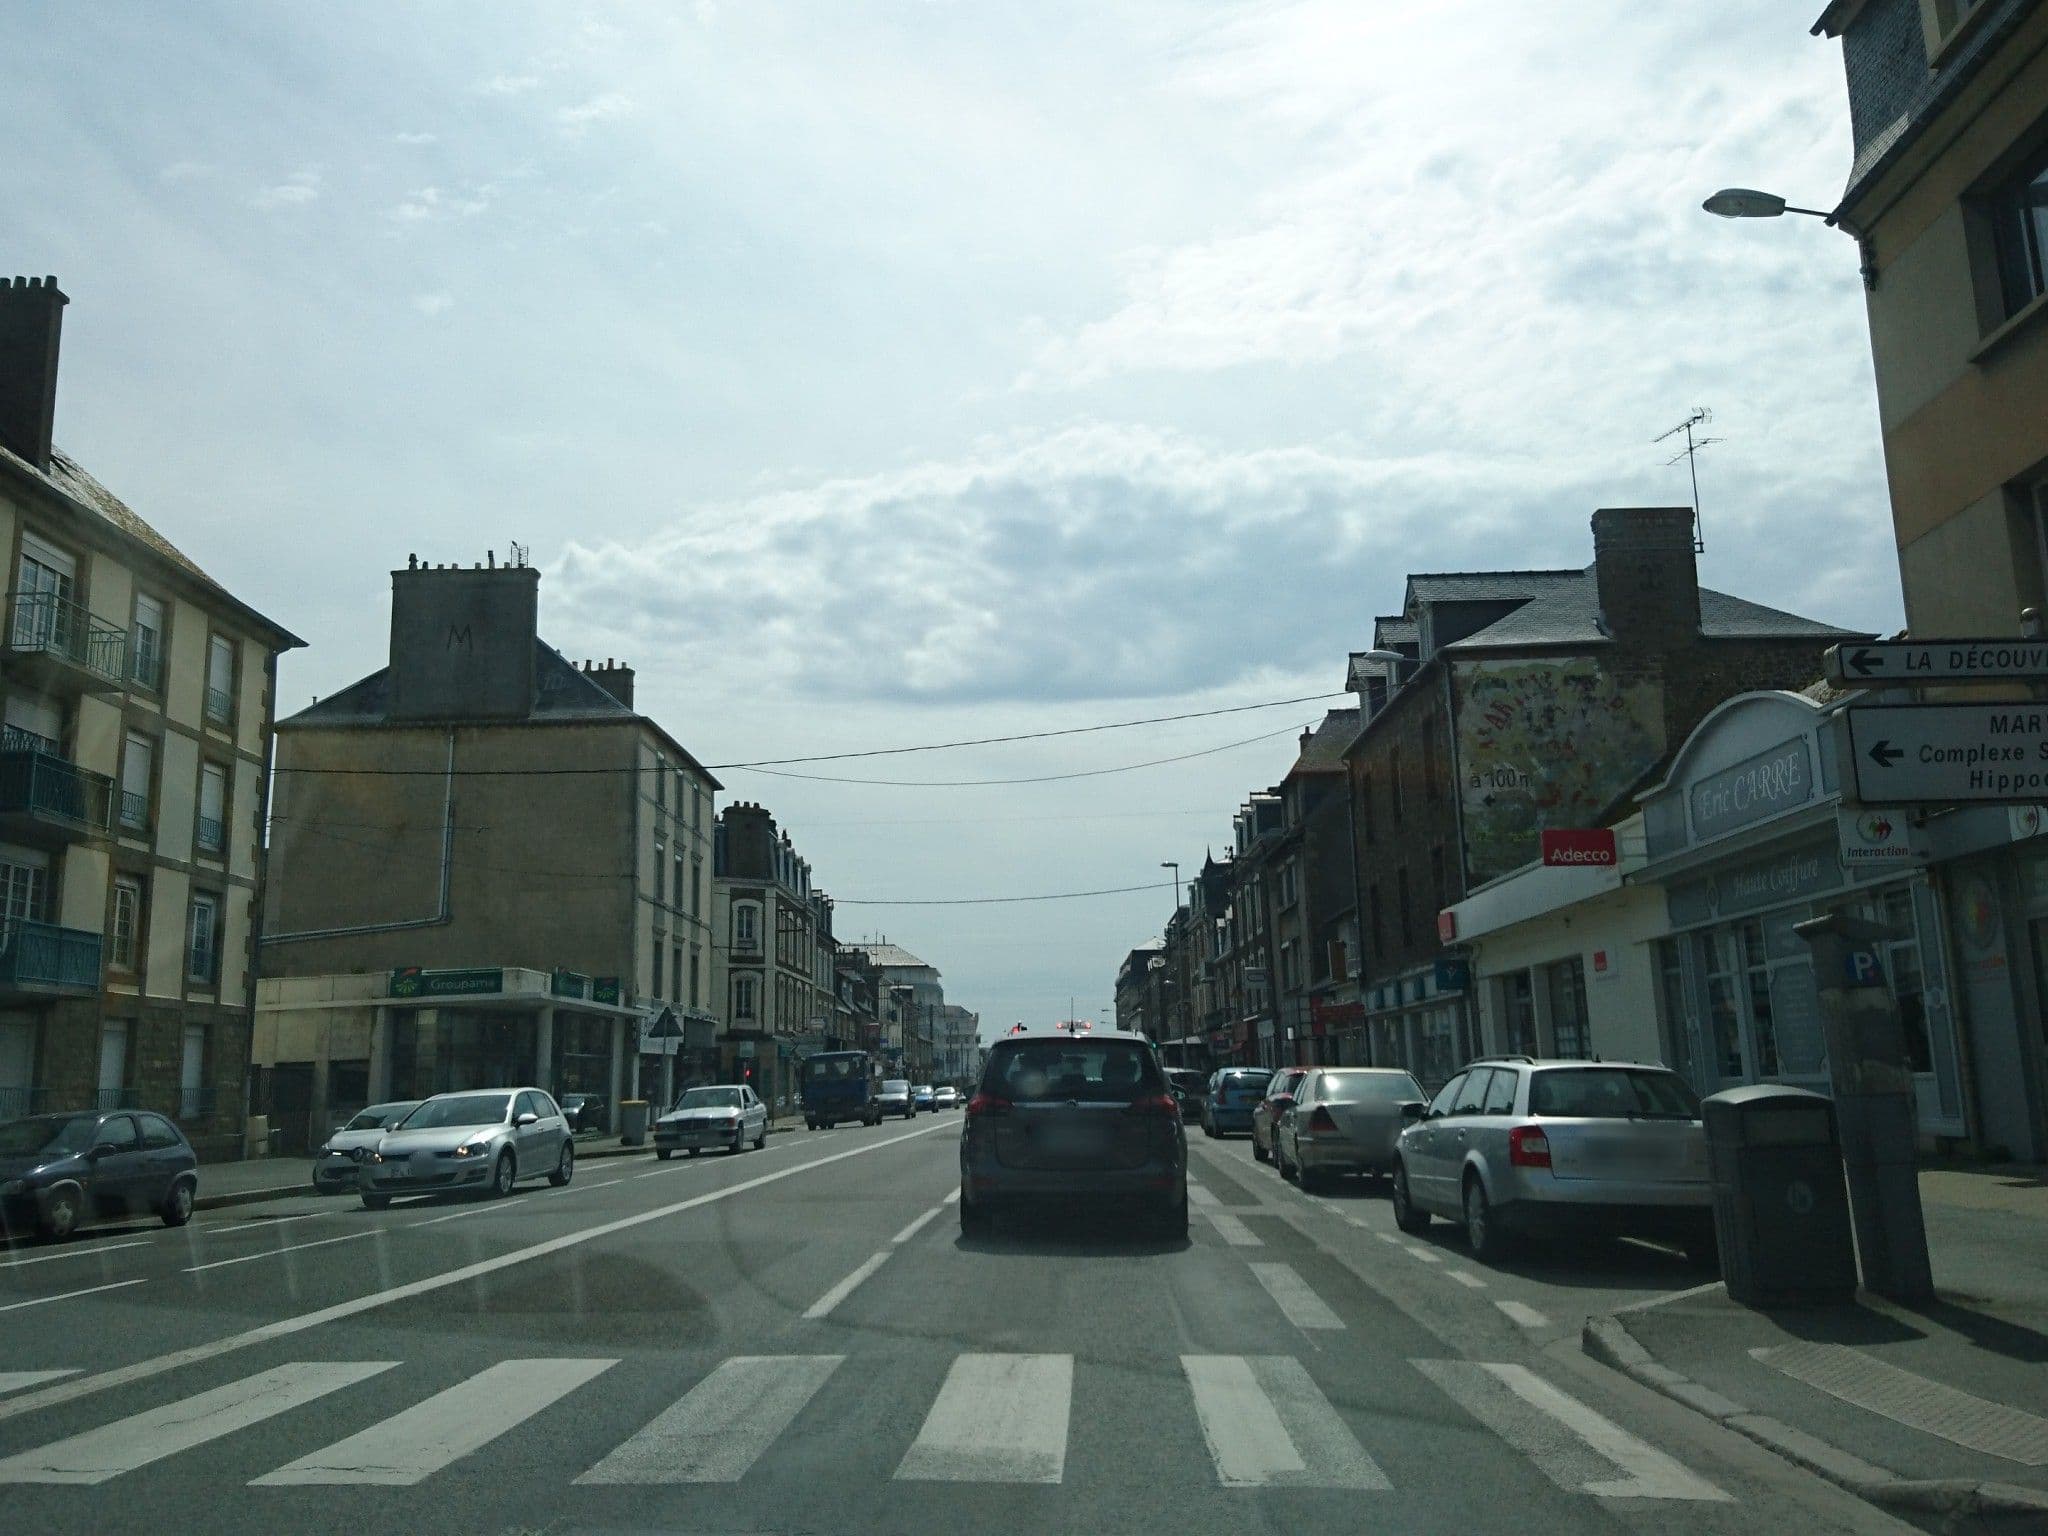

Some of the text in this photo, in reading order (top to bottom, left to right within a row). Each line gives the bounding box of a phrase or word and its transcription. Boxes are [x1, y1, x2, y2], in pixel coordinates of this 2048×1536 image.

[1906, 644, 2048, 670] LA DÉCOUV
[1990, 714, 2048, 734] MAR
[1918, 743, 2025, 767] Complexe
[1551, 848, 1610, 863] Adecco
[1847, 846, 1909, 858] Interaction
[1853, 951, 1873, 981] P
